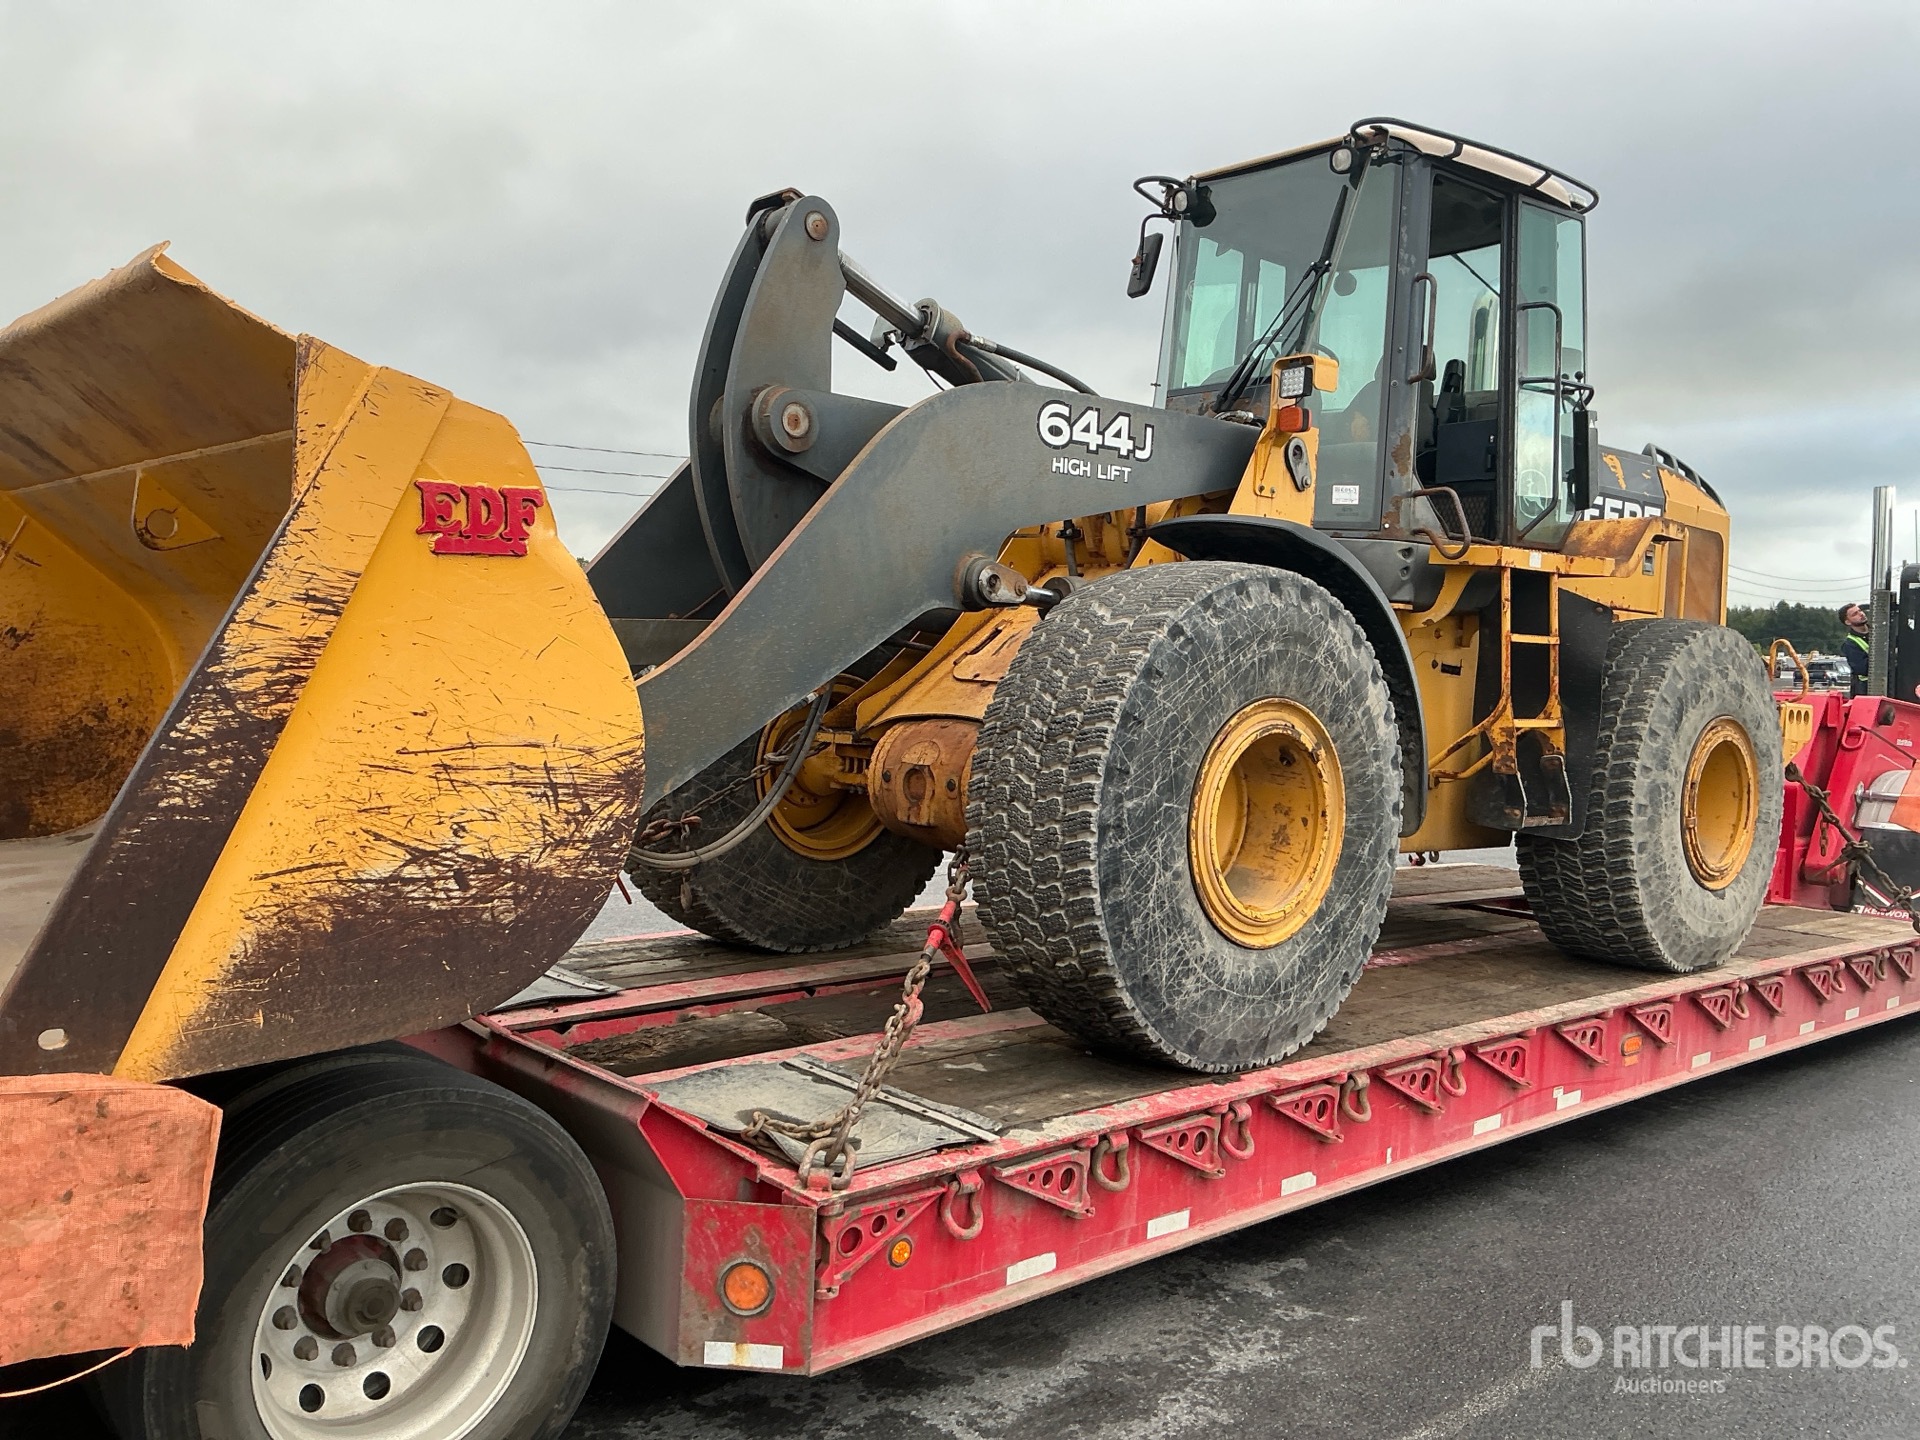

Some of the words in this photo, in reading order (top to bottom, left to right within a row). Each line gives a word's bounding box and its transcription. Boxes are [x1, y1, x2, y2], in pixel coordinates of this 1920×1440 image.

[1038, 401, 1154, 461] 644J
[1052, 457, 1091, 478] HIGH
[1097, 463, 1132, 483] LIFT
[415, 480, 544, 543] EDF
